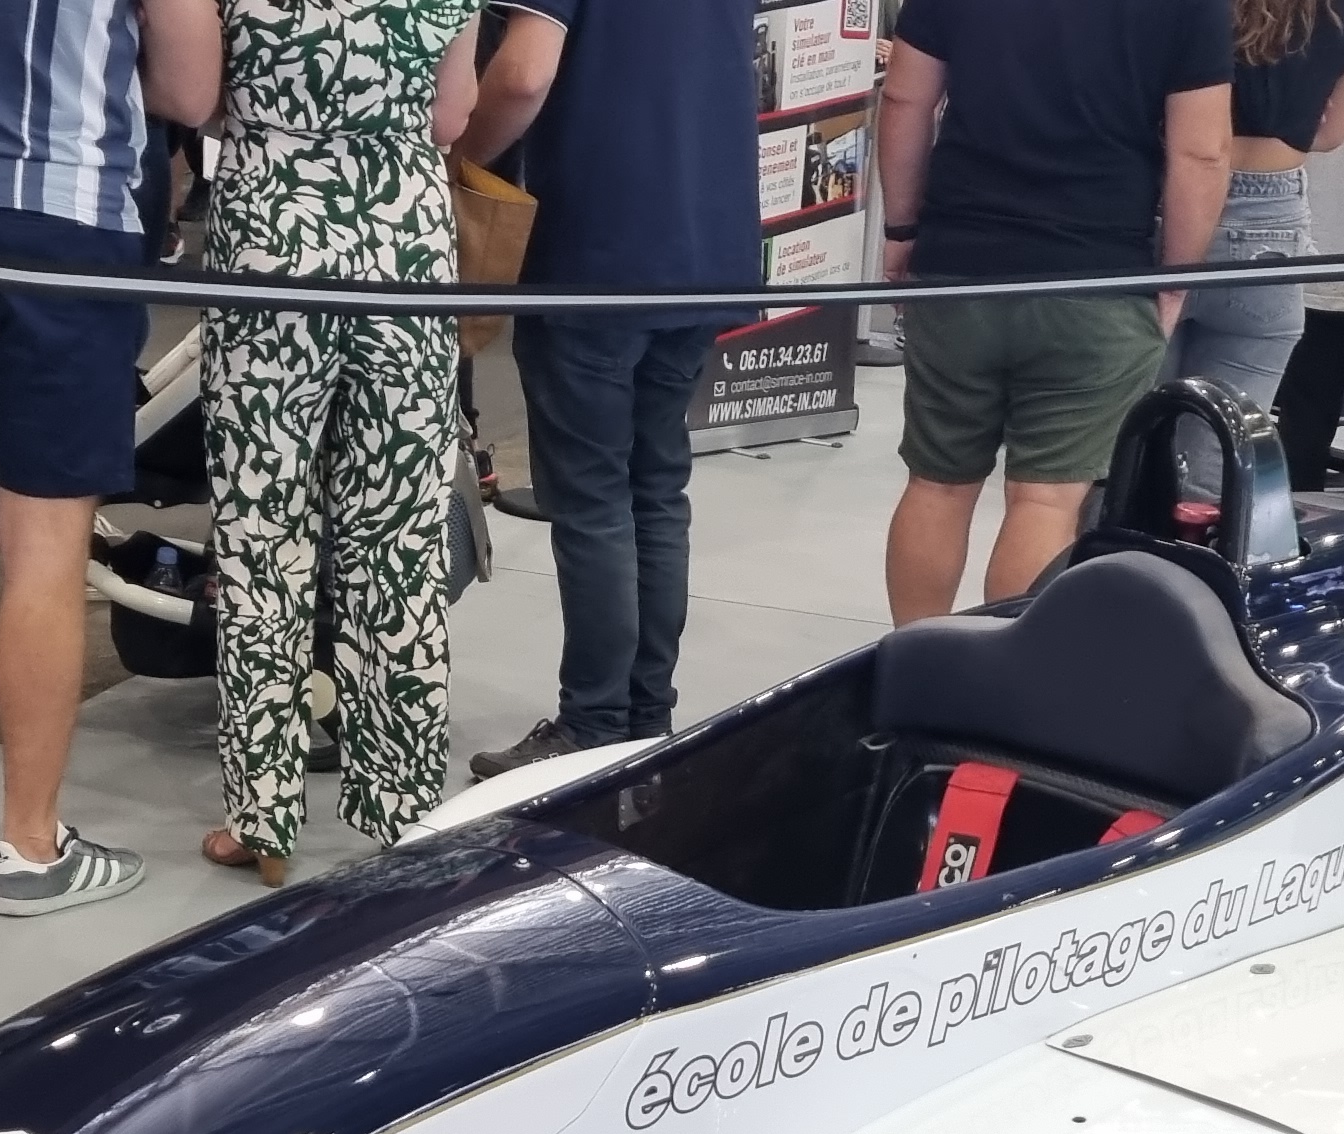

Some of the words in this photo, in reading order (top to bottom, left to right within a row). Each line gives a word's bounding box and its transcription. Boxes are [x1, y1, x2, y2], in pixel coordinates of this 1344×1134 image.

[794, 18, 814, 32] Votre
[792, 32, 831, 51] simulateur
[792, 53, 805, 69] clé
[807, 54, 816, 65] en
[789, 139, 797, 152] et
[778, 240, 811, 259] Location
[777, 263, 786, 276] de
[788, 252, 827, 273] simulateur
[739, 342, 828, 370] 06.61.34.23.61
[731, 371, 832, 393] contact@simrace-in.com
[708, 389, 837, 423] WWW.SIMRACE-IN.COM
[625, 1013, 825, 1130] école
[836, 982, 920, 1061] de
[927, 908, 1173, 1047] pilotage
[1180, 880, 1245, 950] du
